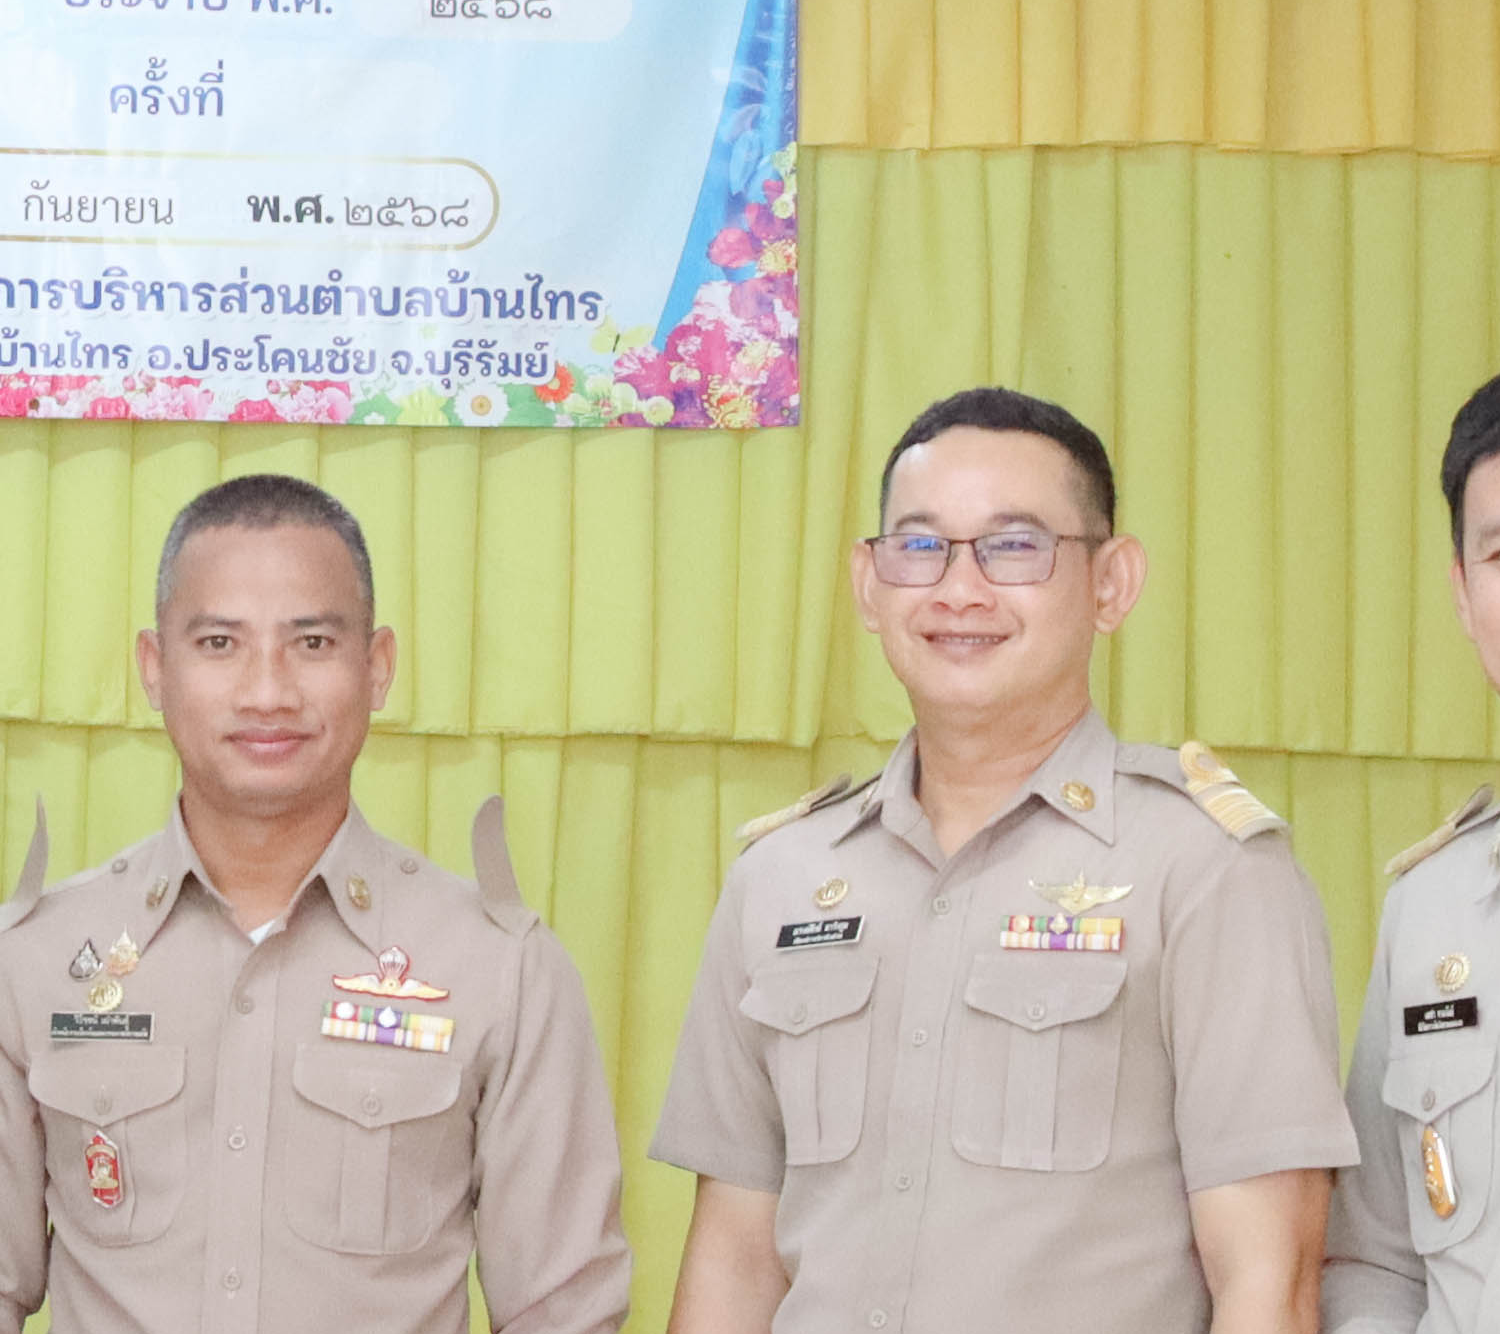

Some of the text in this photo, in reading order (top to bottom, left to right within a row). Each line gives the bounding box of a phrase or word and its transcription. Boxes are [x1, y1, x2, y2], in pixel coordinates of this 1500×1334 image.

[108, 56, 225, 118] ครั้งที่
[22, 179, 174, 226] กันยายน
[146, 335, 378, 377] อ.ประโคนชัย
[390, 339, 550, 391] จ.บุรีรัมย์
